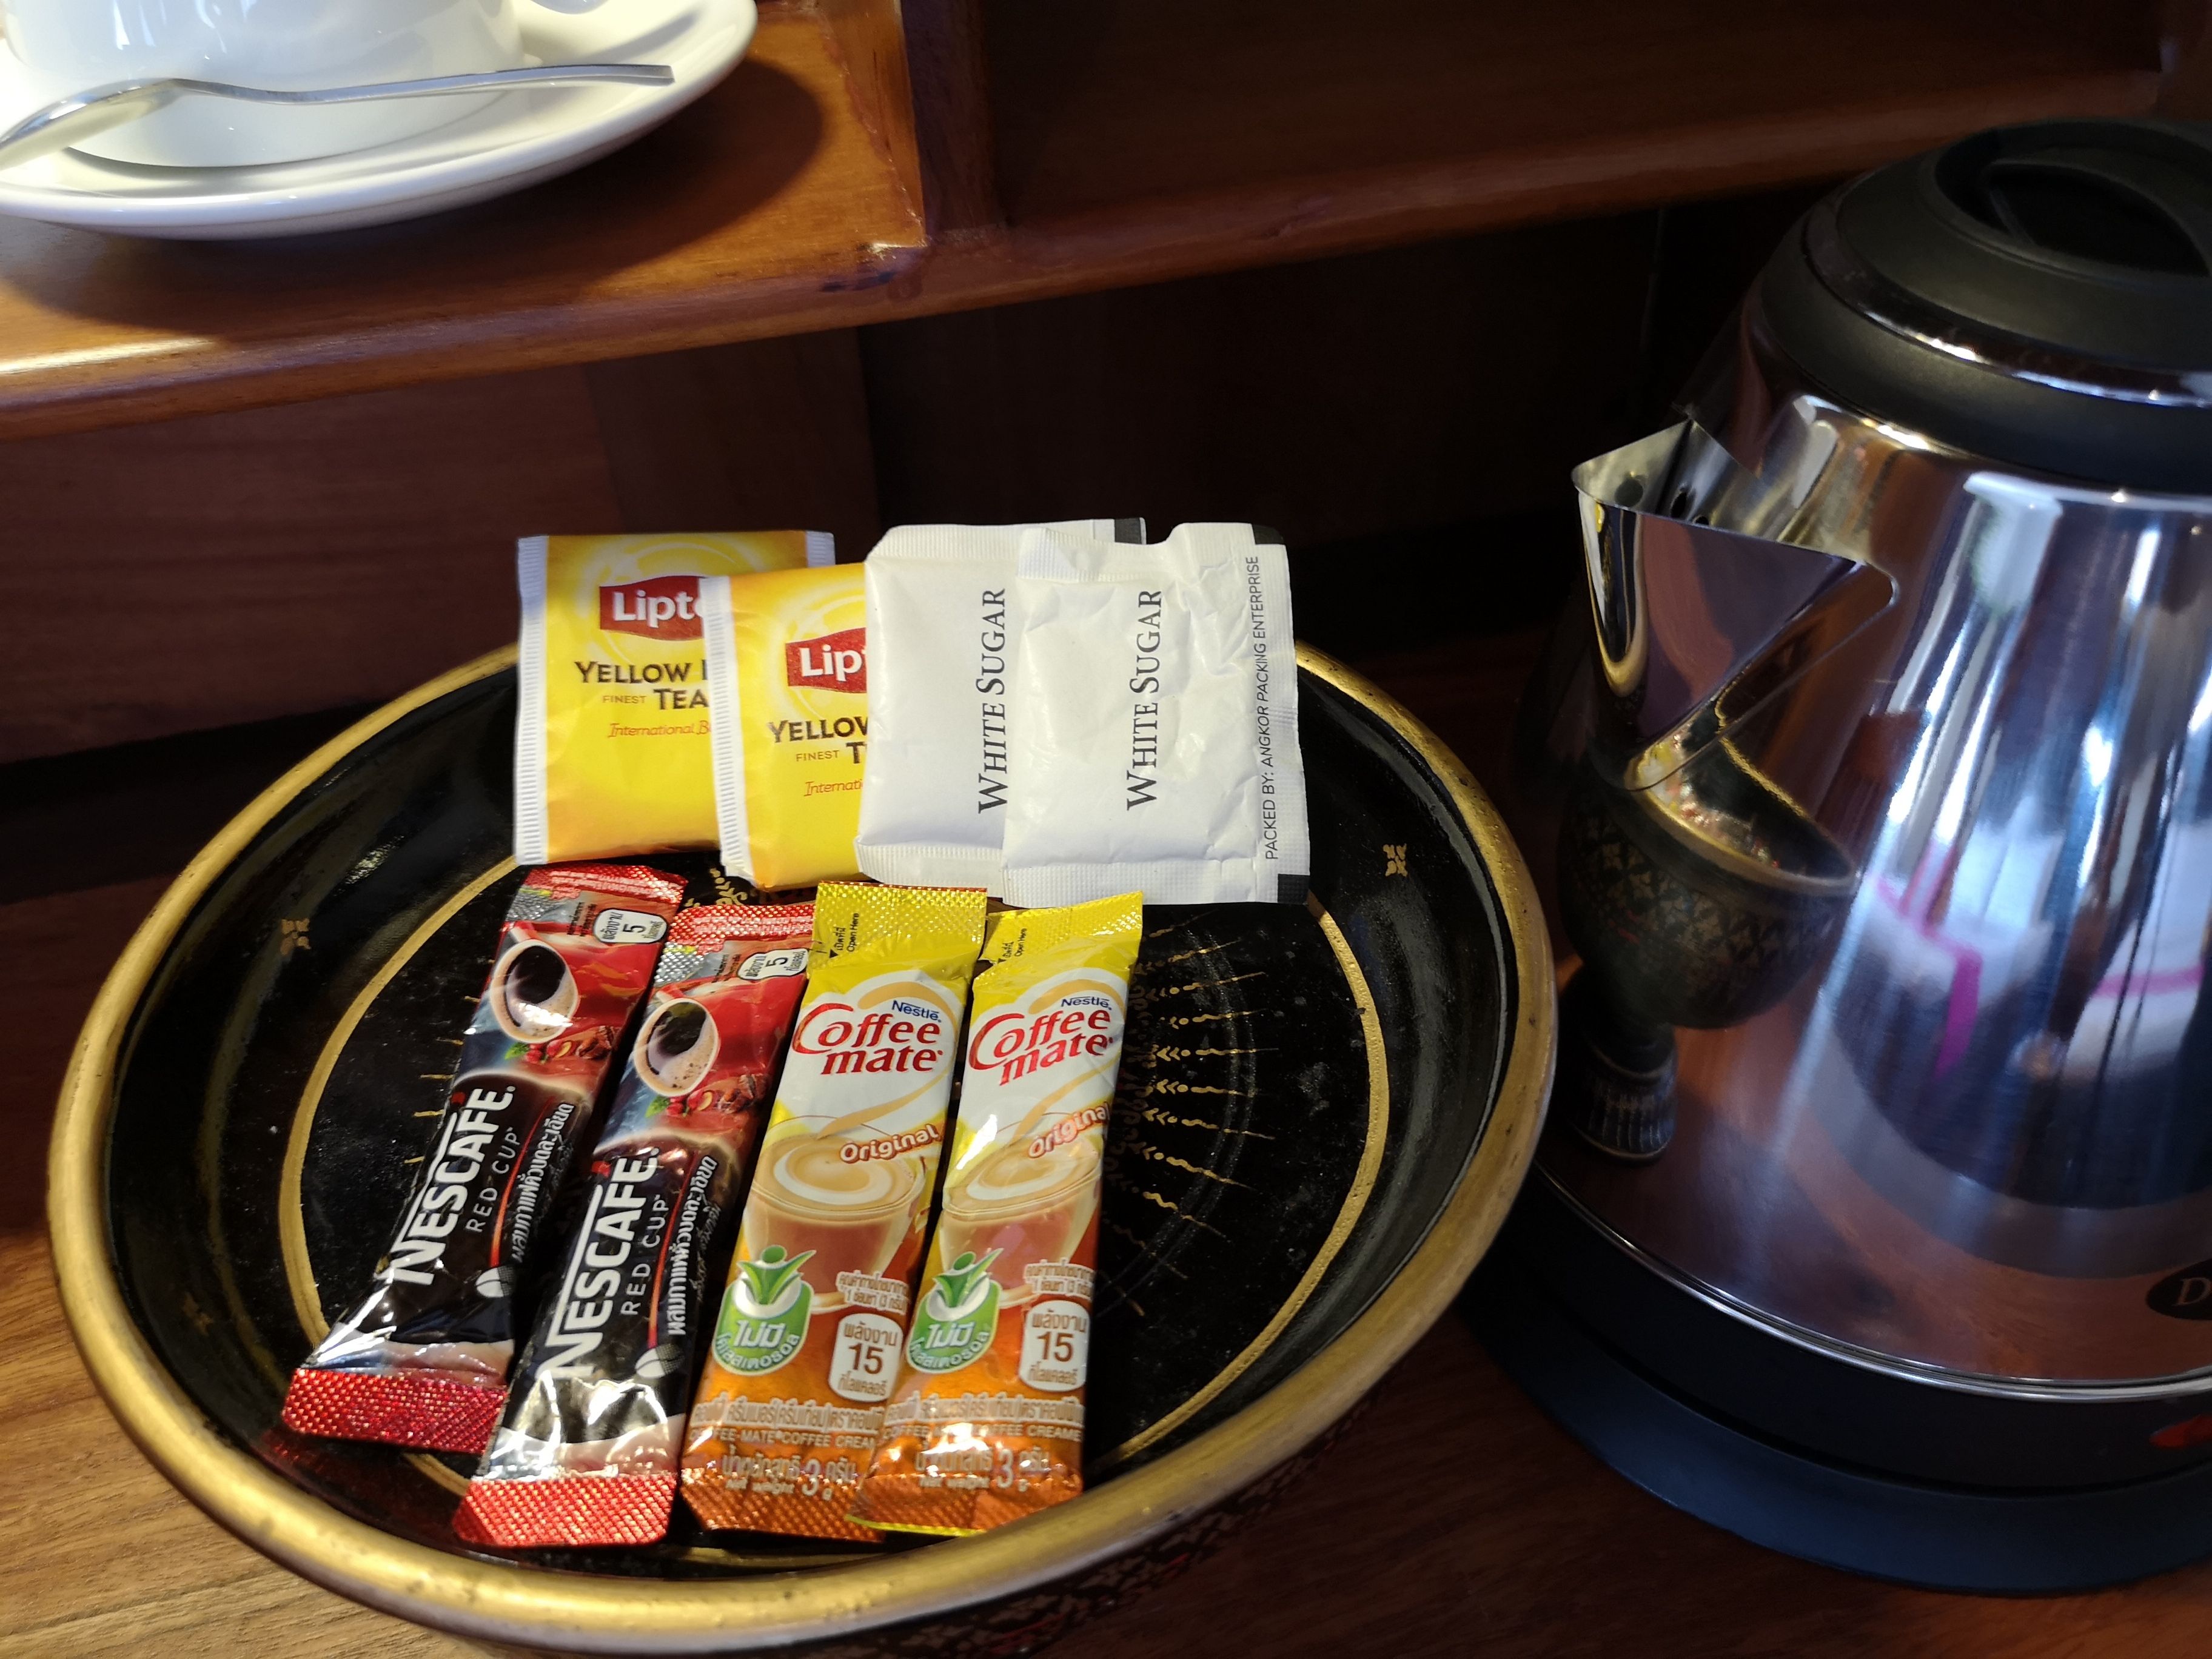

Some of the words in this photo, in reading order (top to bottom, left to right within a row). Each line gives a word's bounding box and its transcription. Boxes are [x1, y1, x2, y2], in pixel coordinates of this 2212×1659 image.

[1245, 555, 1267, 641] ENTERPRISE
[976, 588, 1005, 695] SUGAR
[1129, 589, 1162, 694] SUGAR
[574, 661, 692, 683] YELLOW
[799, 644, 866, 682] Lip
[1255, 644, 1269, 703] PACKING
[602, 695, 647, 704] FINEST
[654, 688, 709, 710] TEA
[608, 722, 695, 738] International
[1258, 706, 1273, 767] ANGKOR
[796, 749, 840, 762] FINEST
[977, 702, 1008, 814] WHITE
[1127, 702, 1158, 811] WHITE
[1261, 771, 1276, 795] BY:
[1263, 799, 1278, 859] PACKED
[622, 923, 646, 934] 5
[850, 913, 859, 930] Here
[846, 932, 857, 952] Open
[765, 957, 788, 967] 5
[792, 1003, 941, 1055] Coffee
[969, 1008, 1111, 1071] Coffee
[840, 1124, 942, 1164] Original
[465, 1187, 498, 1233] RED
[620, 1263, 651, 1315] RED
[844, 1321, 897, 1346] พลังงาน
[1032, 1309, 1087, 1332] พลังงาน
[849, 1342, 883, 1375] 15
[1037, 1331, 1074, 1362] 15
[782, 1431, 831, 1447] COFFEE
[802, 1458, 820, 1496] 3
[997, 1449, 1013, 1489] 3
